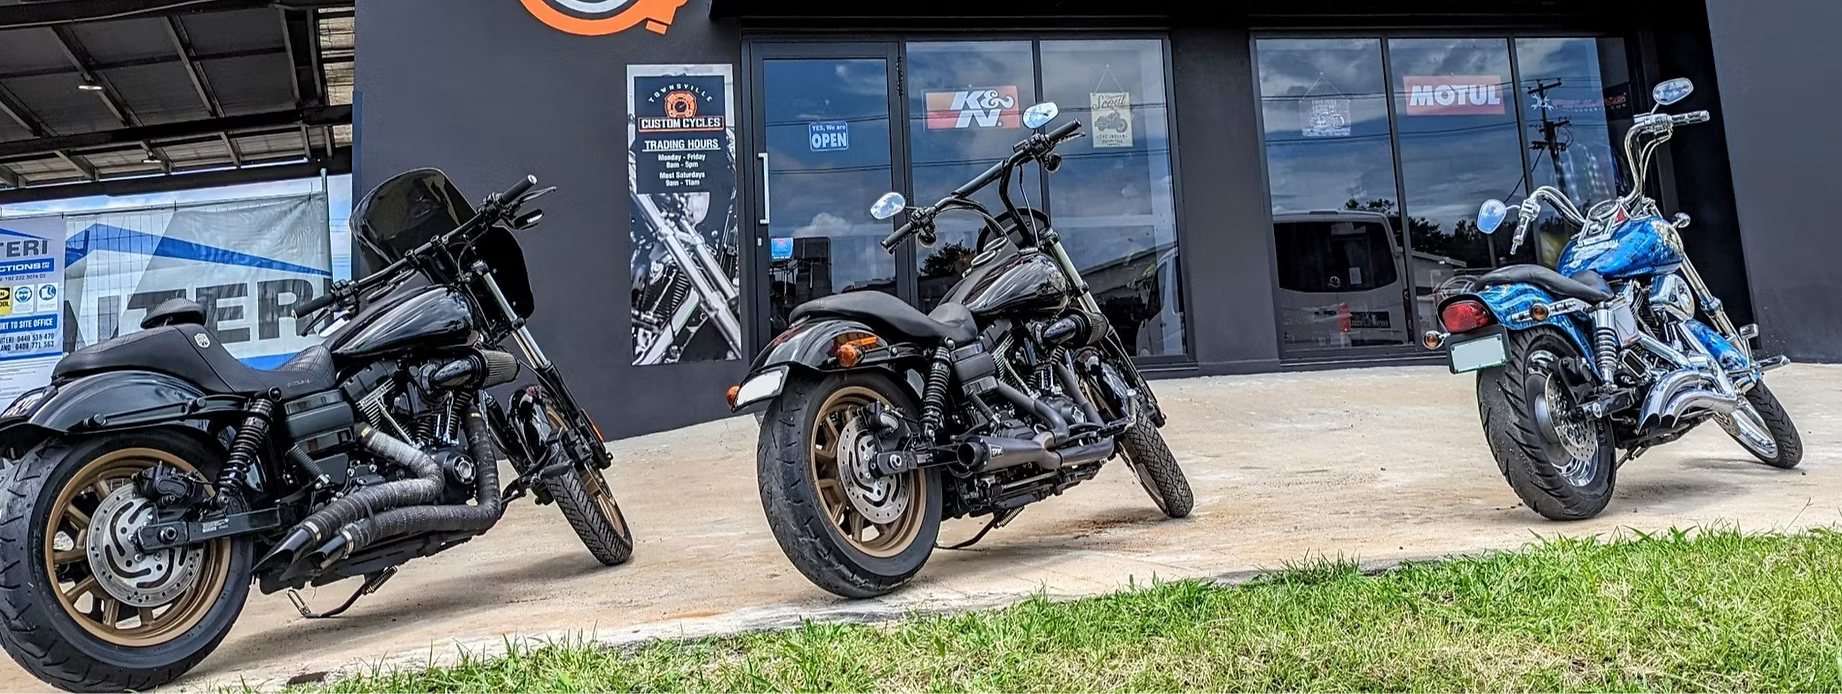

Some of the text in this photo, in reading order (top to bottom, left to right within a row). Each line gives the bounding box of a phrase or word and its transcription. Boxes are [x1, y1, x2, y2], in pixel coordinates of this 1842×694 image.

[648, 84, 713, 103] TOWNSVILLE
[1410, 85, 1500, 106] MOTUL
[1092, 94, 1127, 110] Scout
[642, 118, 720, 129] CUSTOM CYCLES
[644, 139, 718, 150] TRADING HOURS
[812, 132, 846, 148] OPEN
[687, 153, 706, 161] Friday
[675, 171, 705, 179] Saturdays
[10, 321, 18, 329] TO
[19, 320, 32, 328] SITE
[33, 318, 53, 327] OFFICE
